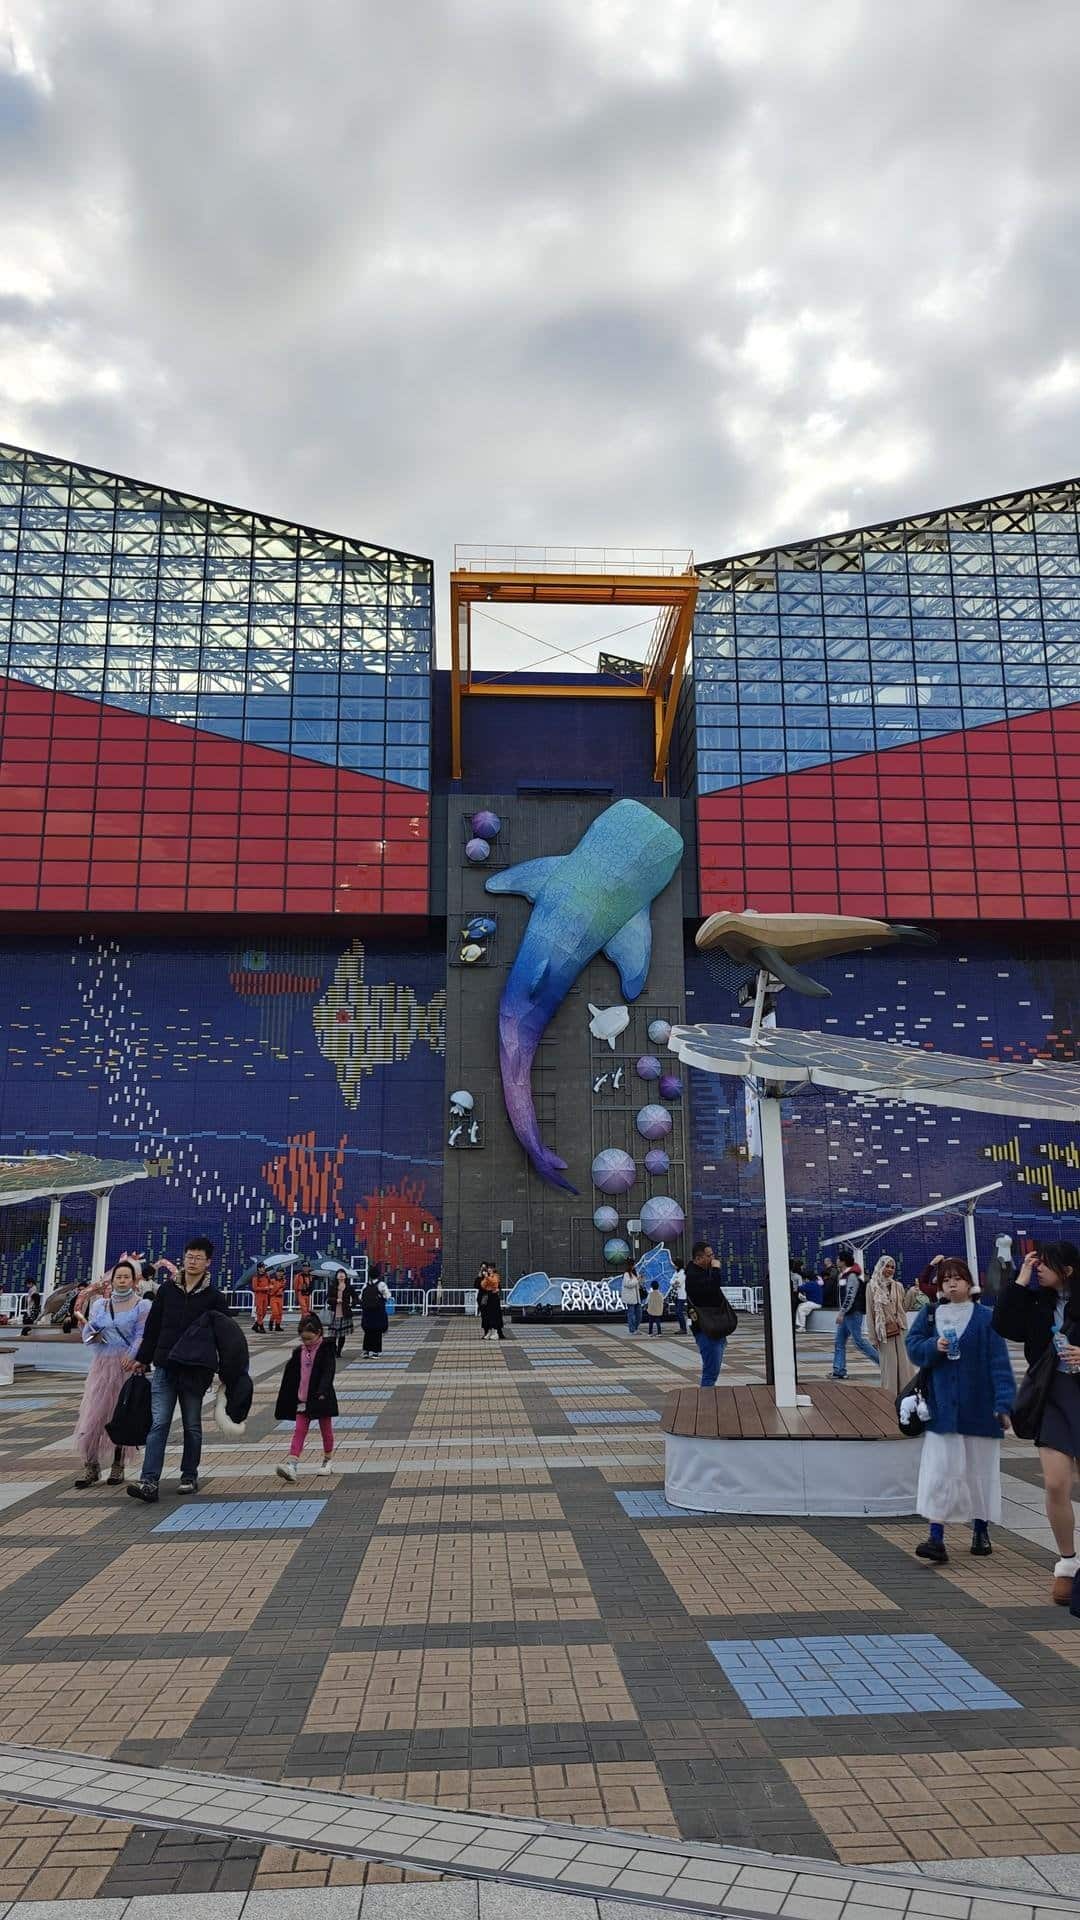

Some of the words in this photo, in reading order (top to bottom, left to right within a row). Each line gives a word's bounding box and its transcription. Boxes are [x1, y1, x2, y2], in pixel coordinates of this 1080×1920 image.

[561, 1281, 610, 1292] OSAKA
[561, 1290, 621, 1301] AQUARI
[561, 1300, 629, 1311] KAIYUKA
